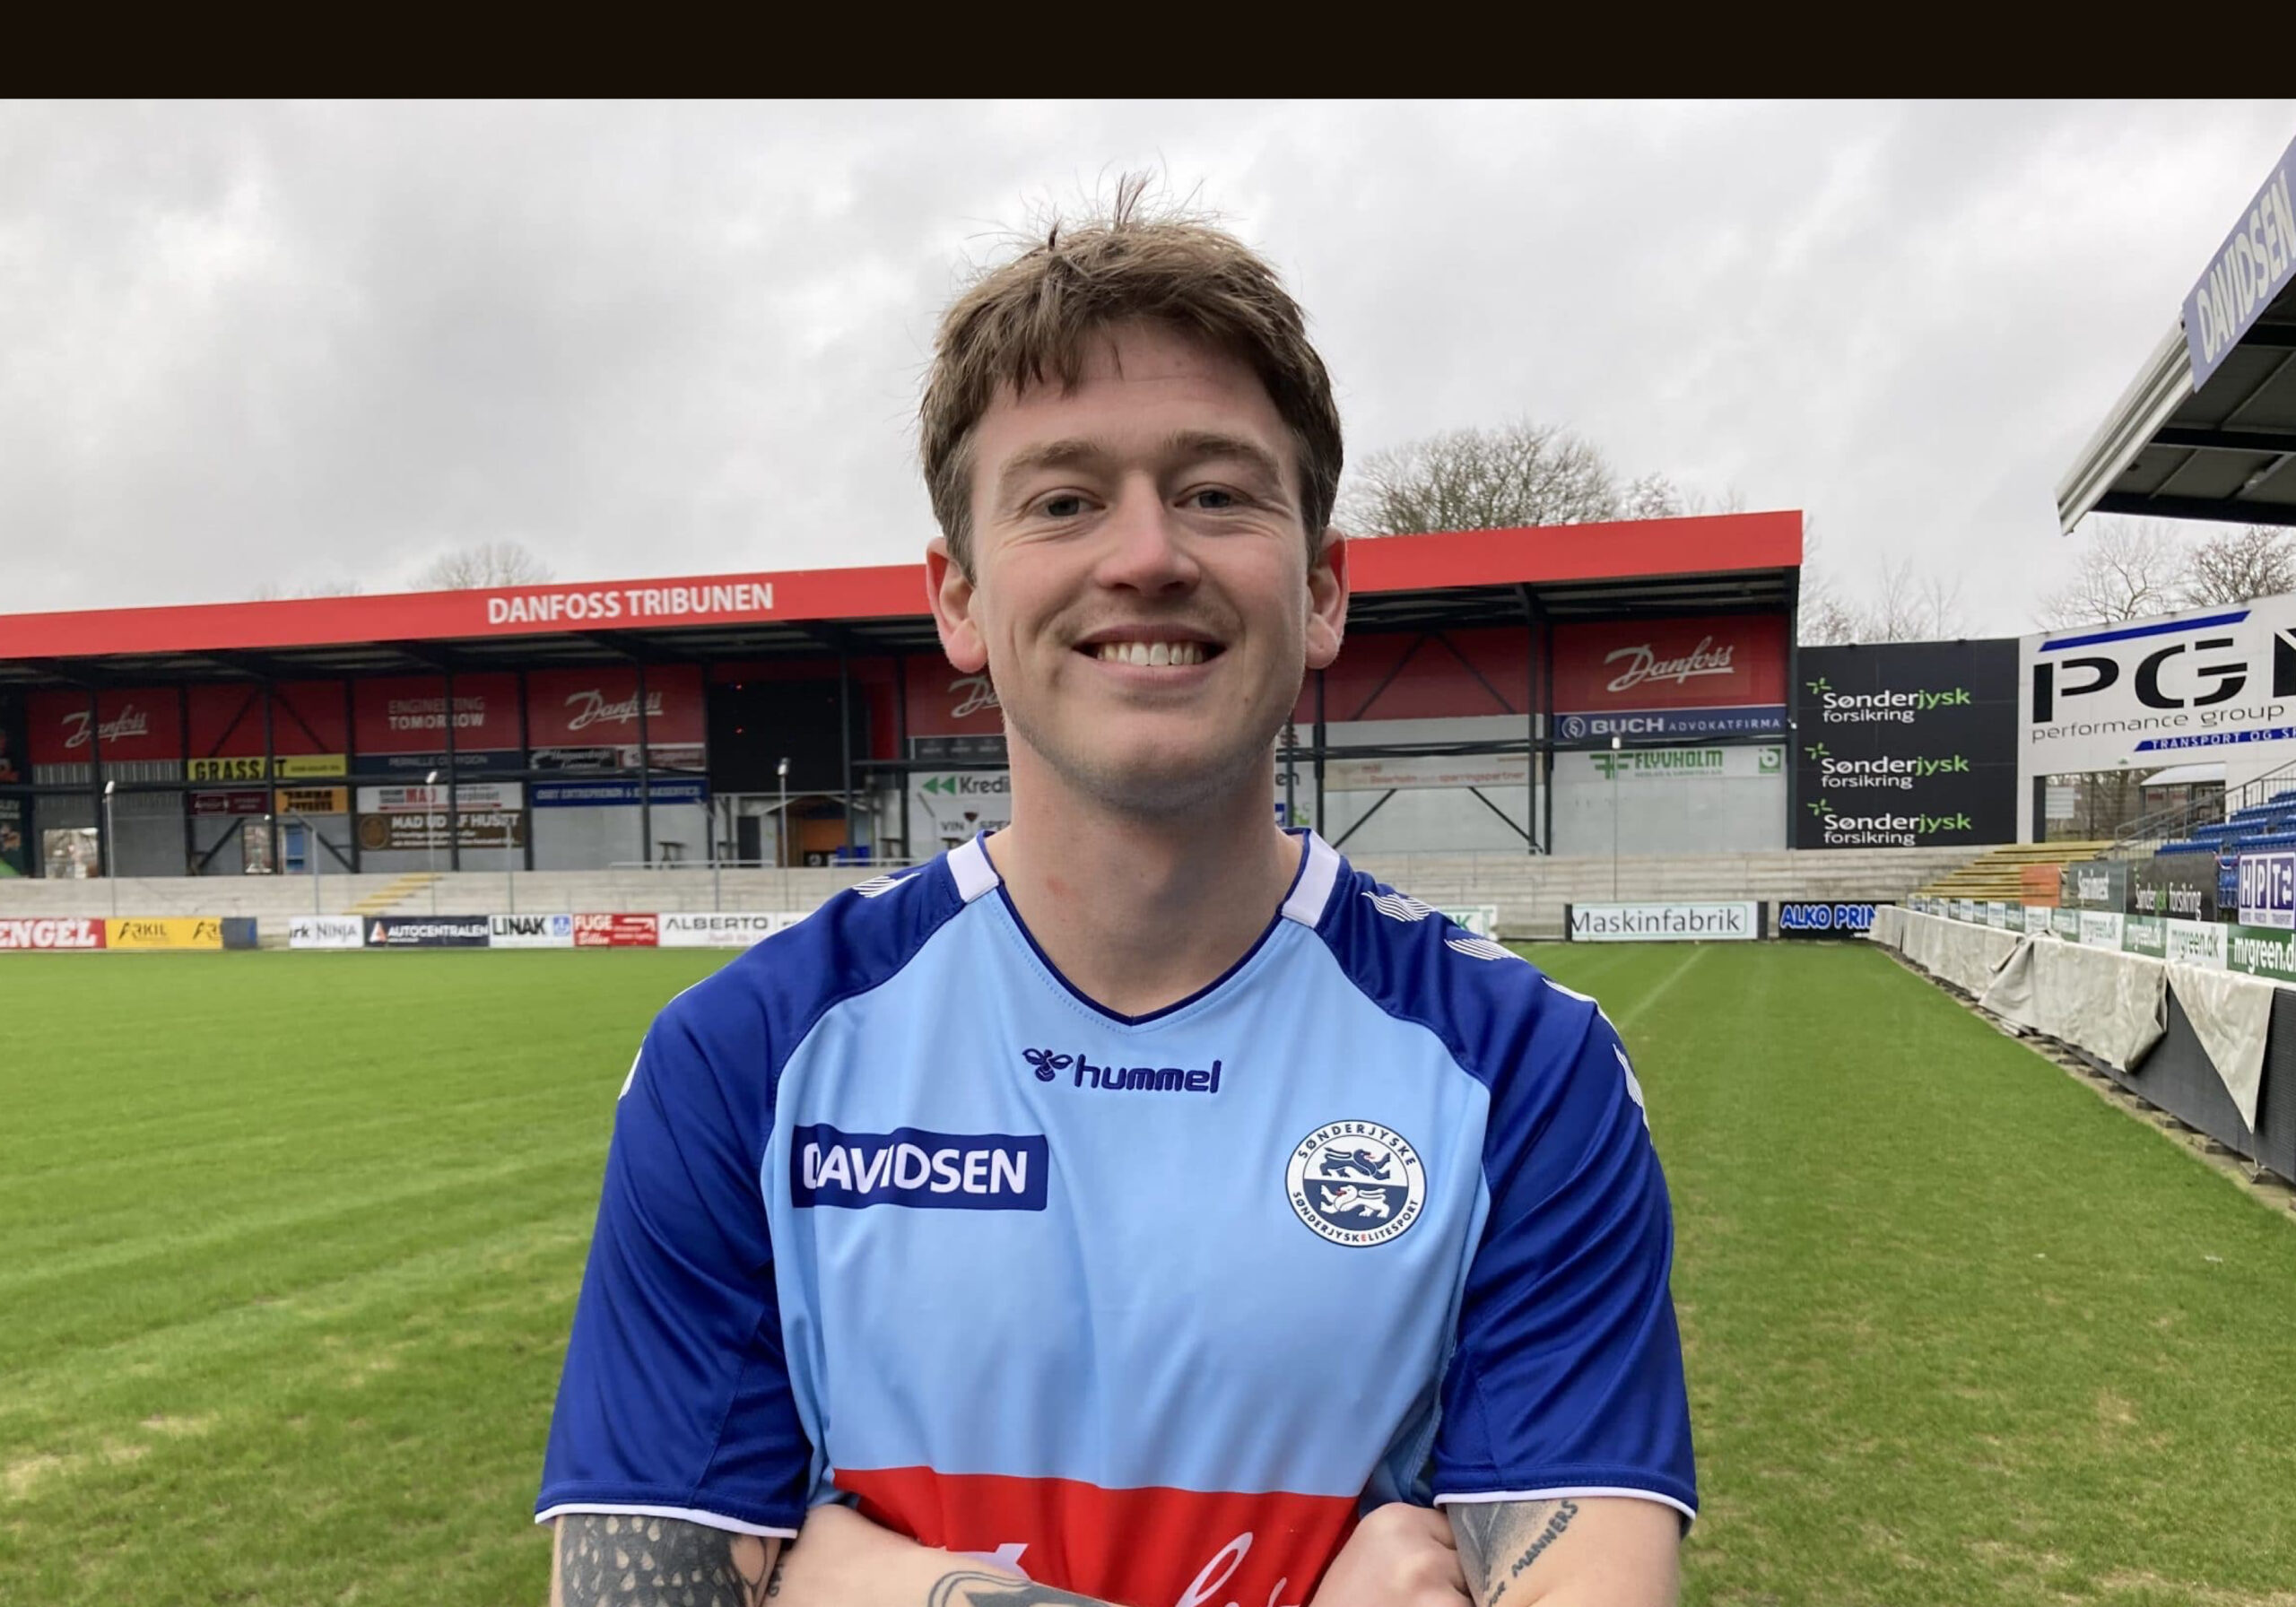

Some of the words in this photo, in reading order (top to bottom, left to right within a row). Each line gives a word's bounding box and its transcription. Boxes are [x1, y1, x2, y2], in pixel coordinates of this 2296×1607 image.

[2197, 169, 2296, 363] DAVIDSEN
[488, 591, 621, 624] DANFOSS
[625, 583, 773, 616] TRIBUNEN
[1605, 636, 1735, 692] Danfoss
[1822, 688, 1971, 709] Sønderjysk
[1590, 717, 1665, 735] BUCH
[1668, 718, 1781, 732] ADVOKATFIRMA
[1822, 708, 1915, 724] forsikring
[2032, 716, 2188, 743] performance
[2200, 704, 2284, 727] group
[2152, 733, 2240, 750] TRANSPORT
[2249, 730, 2273, 742] OG
[1821, 754, 1970, 776] Sønderjysk
[1821, 774, 1913, 789] forsikring
[1823, 812, 1971, 834] Sønderjysk
[1823, 831, 1916, 847] forsikring
[493, 917, 546, 936] LINAK
[665, 916, 769, 930] ALBERTO
[1570, 906, 1740, 934] Maskinfabrik
[1779, 904, 1831, 929] ALKO
[387, 924, 489, 938] AUTOCENTRALEN
[1074, 1055, 1222, 1093] hummel
[1298, 1124, 1416, 1166] SØNDERJYSKE
[803, 1142, 1027, 1195] DAVIDSEN
[1292, 1191, 1419, 1243] SØNDERJYSKELITESPORT
[1511, 1498, 1578, 1578] MANNERS
